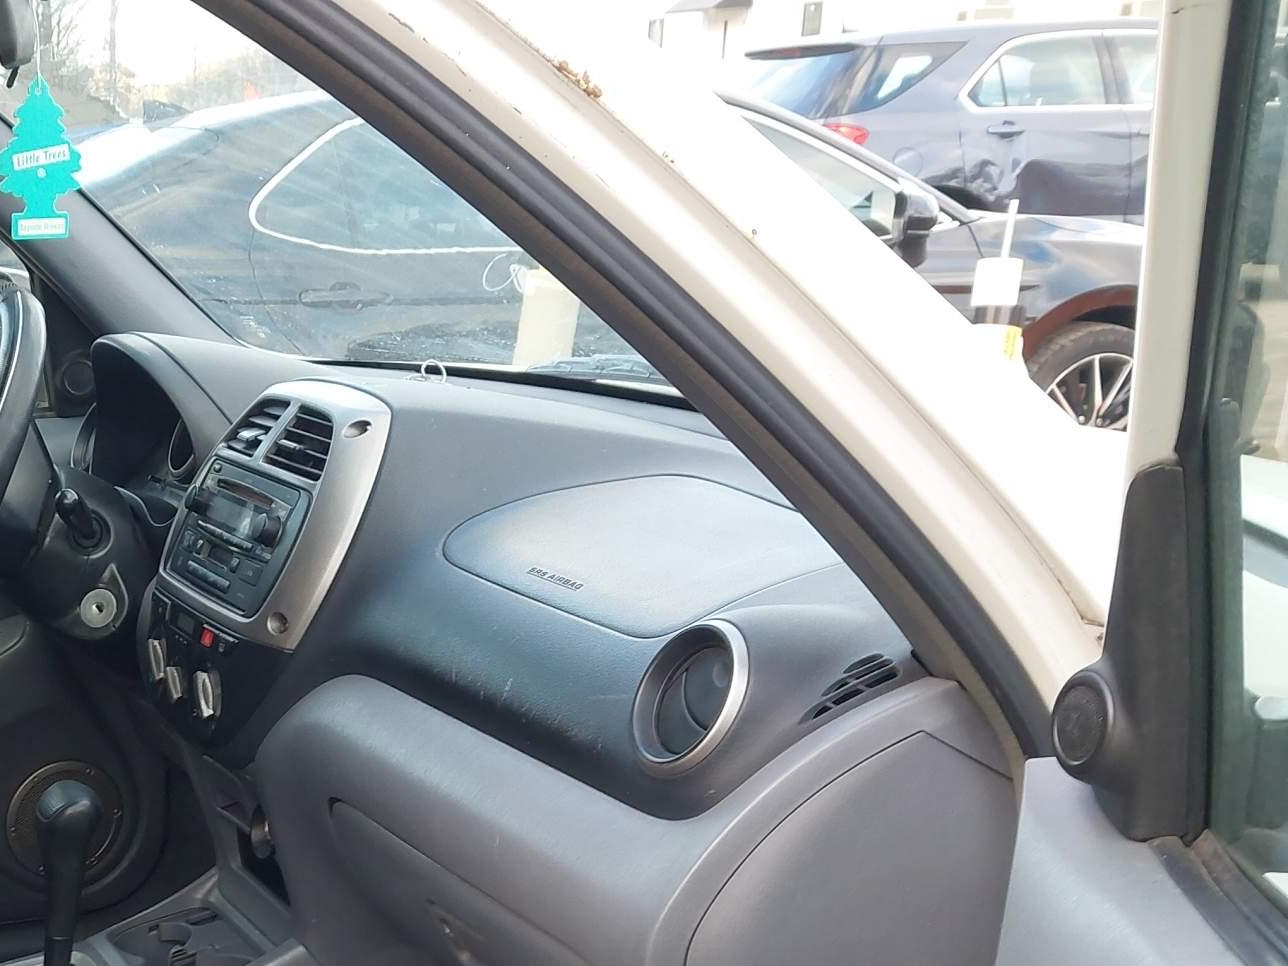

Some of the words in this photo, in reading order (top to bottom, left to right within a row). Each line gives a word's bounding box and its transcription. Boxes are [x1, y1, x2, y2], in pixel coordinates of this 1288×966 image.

[16, 152, 40, 168] Little
[43, 149, 67, 161] Trees
[528, 567, 549, 577] SRS
[546, 574, 584, 590] AIRBAG
